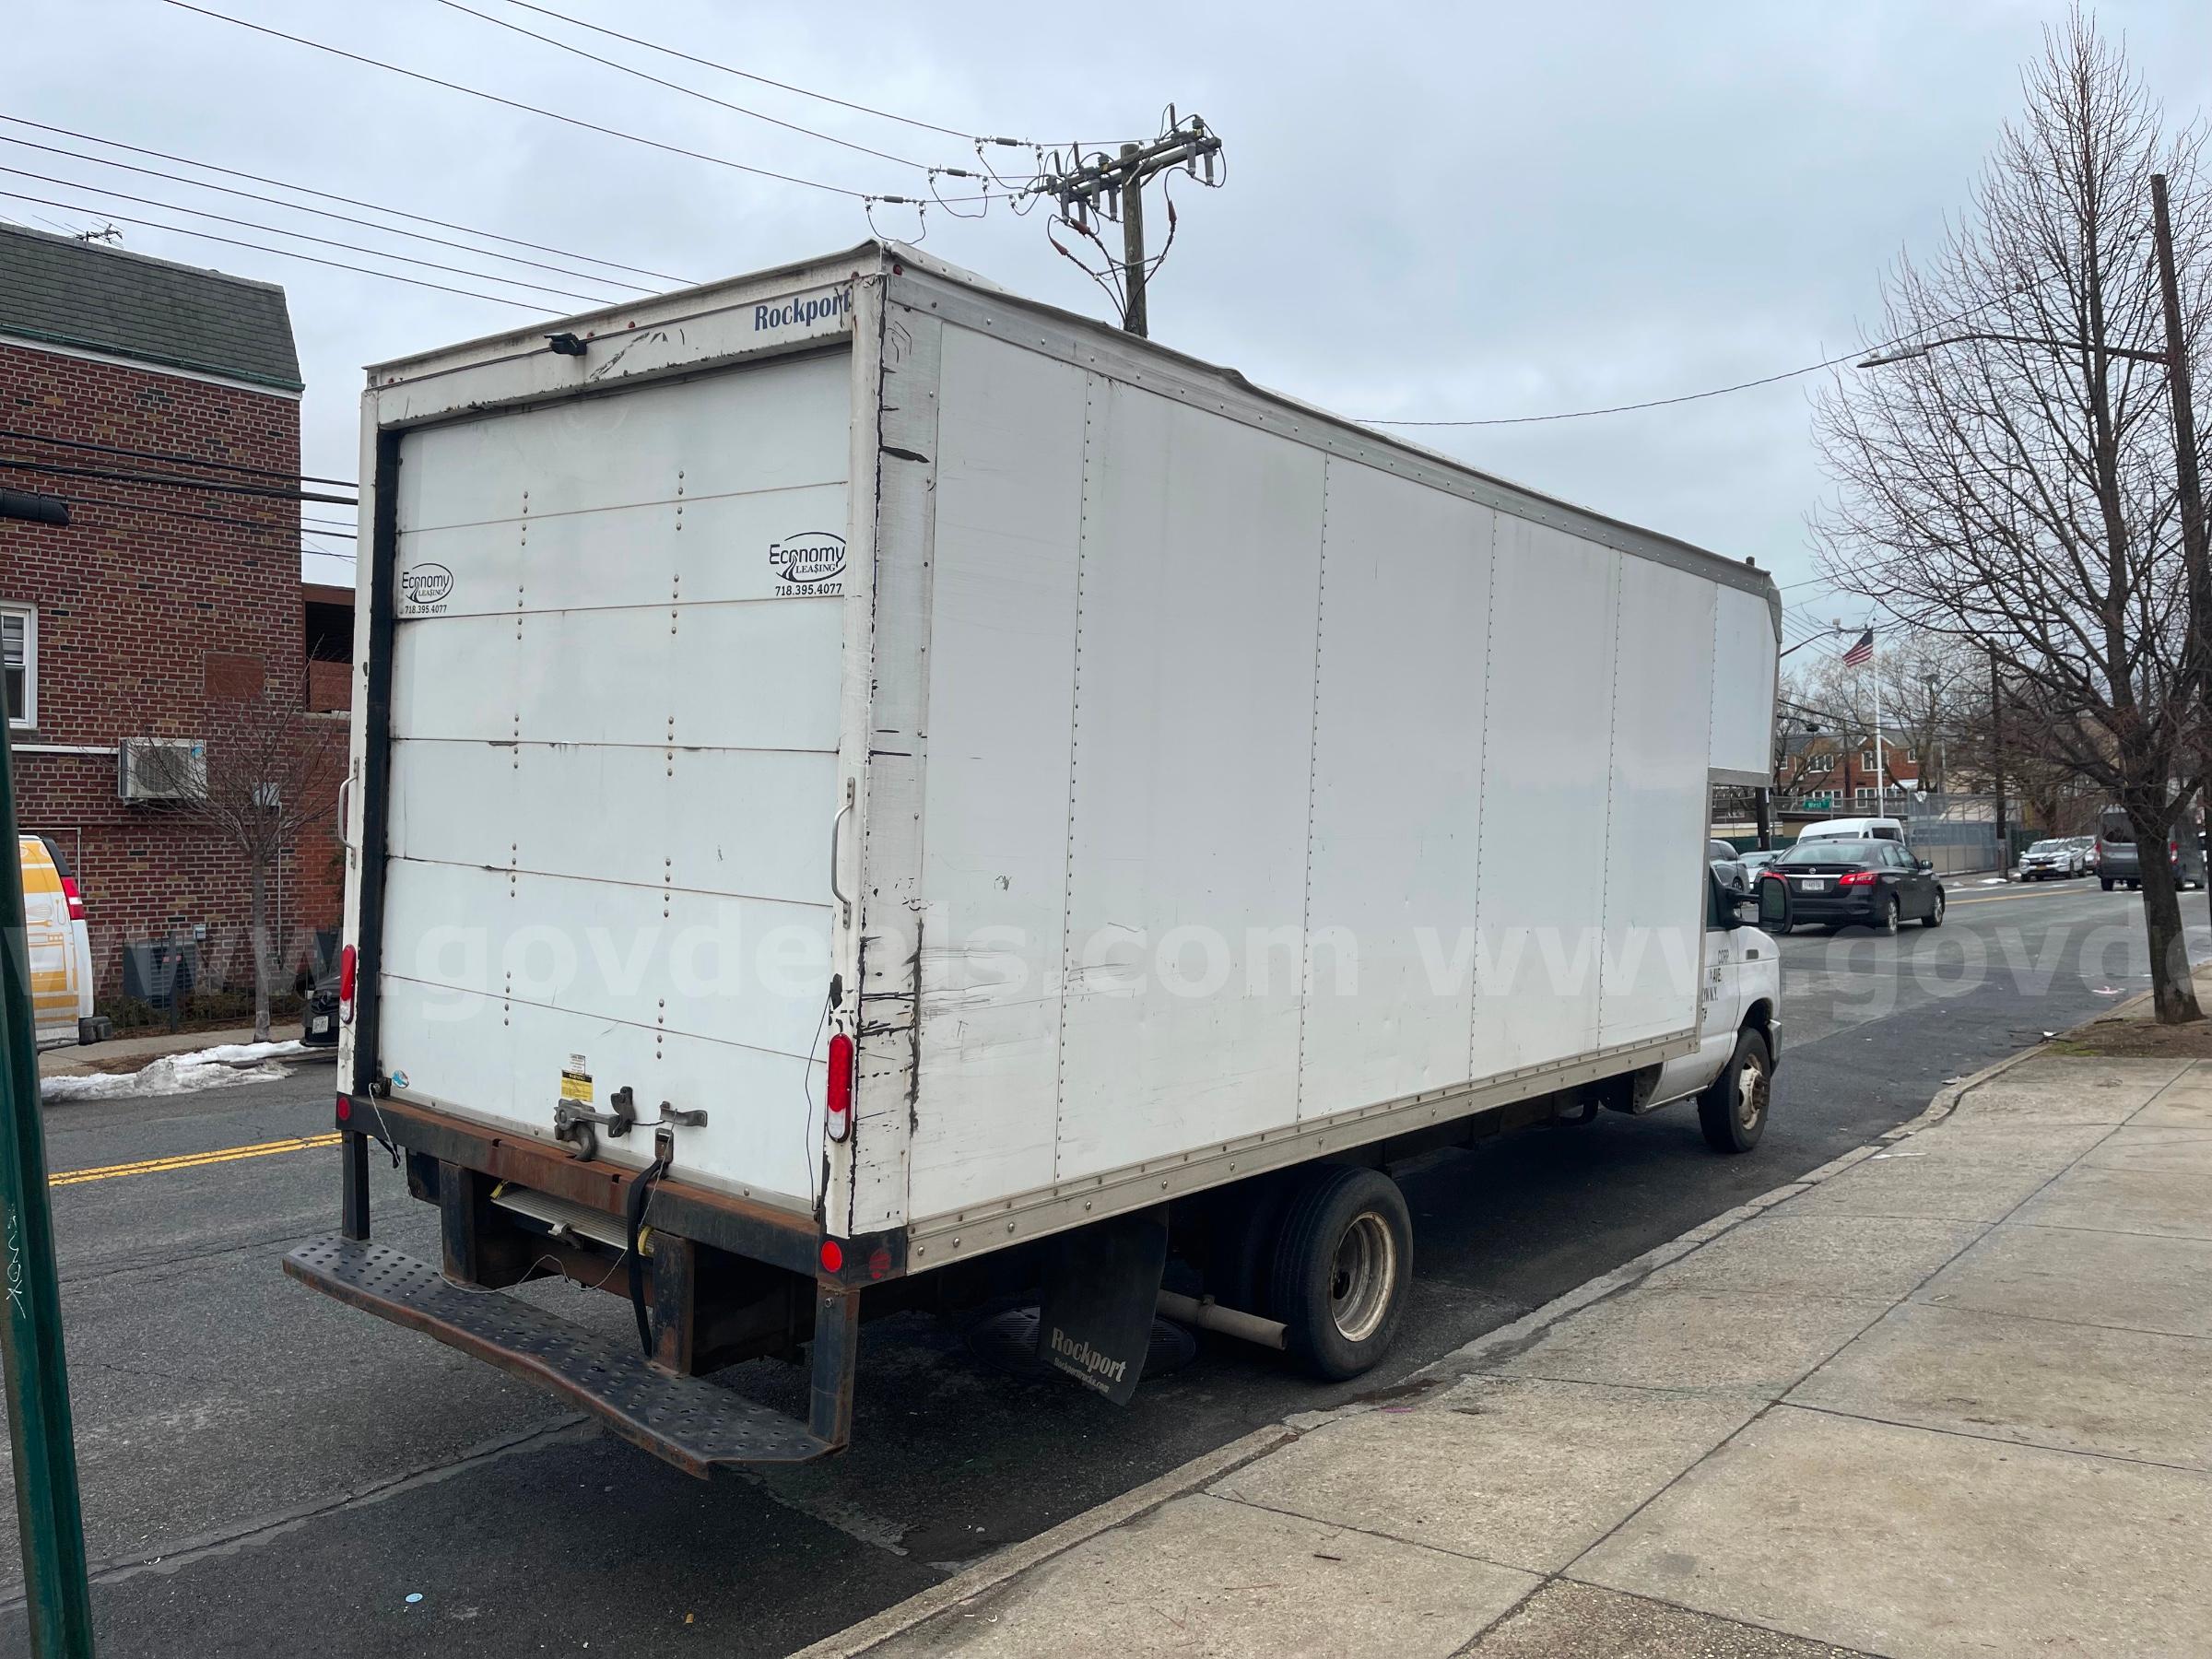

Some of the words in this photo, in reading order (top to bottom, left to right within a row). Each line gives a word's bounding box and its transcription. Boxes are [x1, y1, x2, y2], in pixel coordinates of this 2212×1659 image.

[755, 288, 850, 331] Rockport
[770, 544, 845, 568] Economy
[402, 571, 450, 592] Economy
[775, 583, 842, 596] 718.395.4077
[405, 605, 447, 614] 718.395.4077
[1051, 1327, 1126, 1382] Rockport
